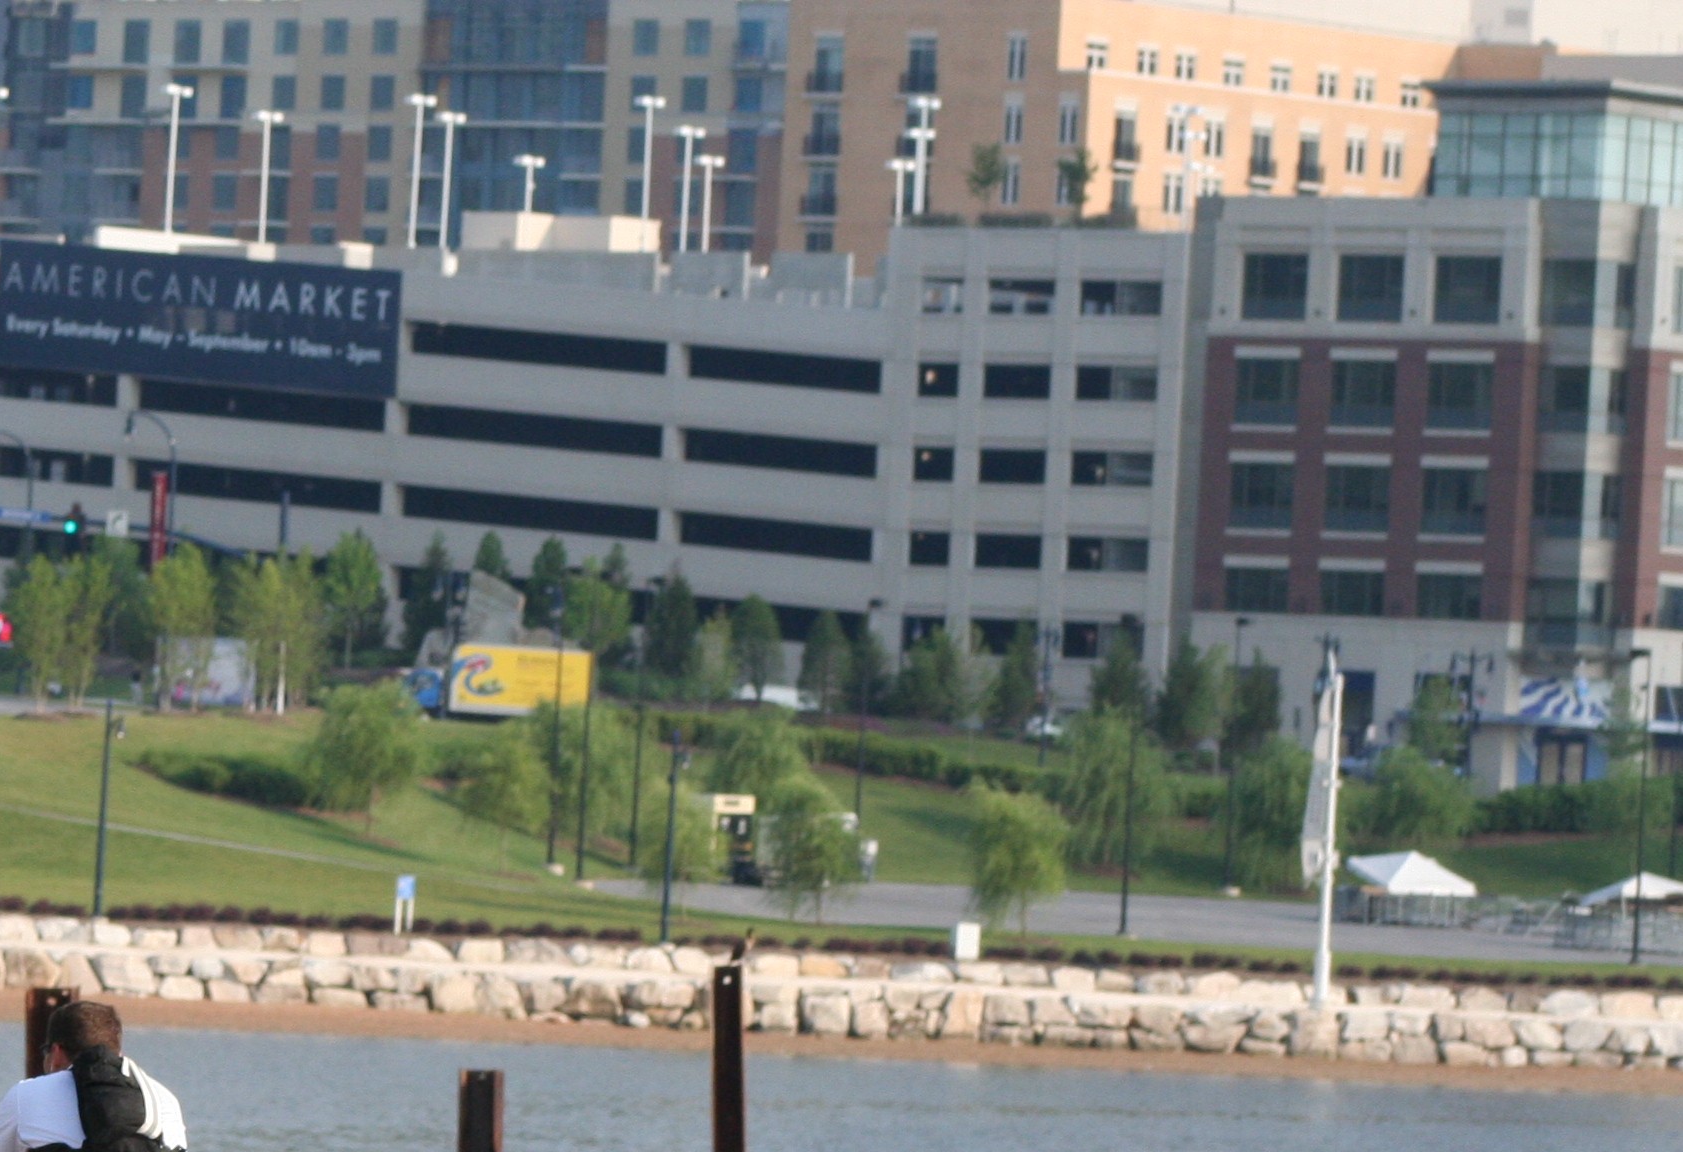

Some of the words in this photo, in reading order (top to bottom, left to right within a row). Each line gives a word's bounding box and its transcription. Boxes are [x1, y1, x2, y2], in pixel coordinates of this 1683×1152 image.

[4, 260, 216, 306] AMERICAN
[233, 278, 392, 321] MARKET
[6, 313, 50, 340] Every
[52, 317, 121, 345] Saturday
[138, 325, 174, 350] May
[188, 328, 269, 353] September
[290, 336, 333, 358] 10am
